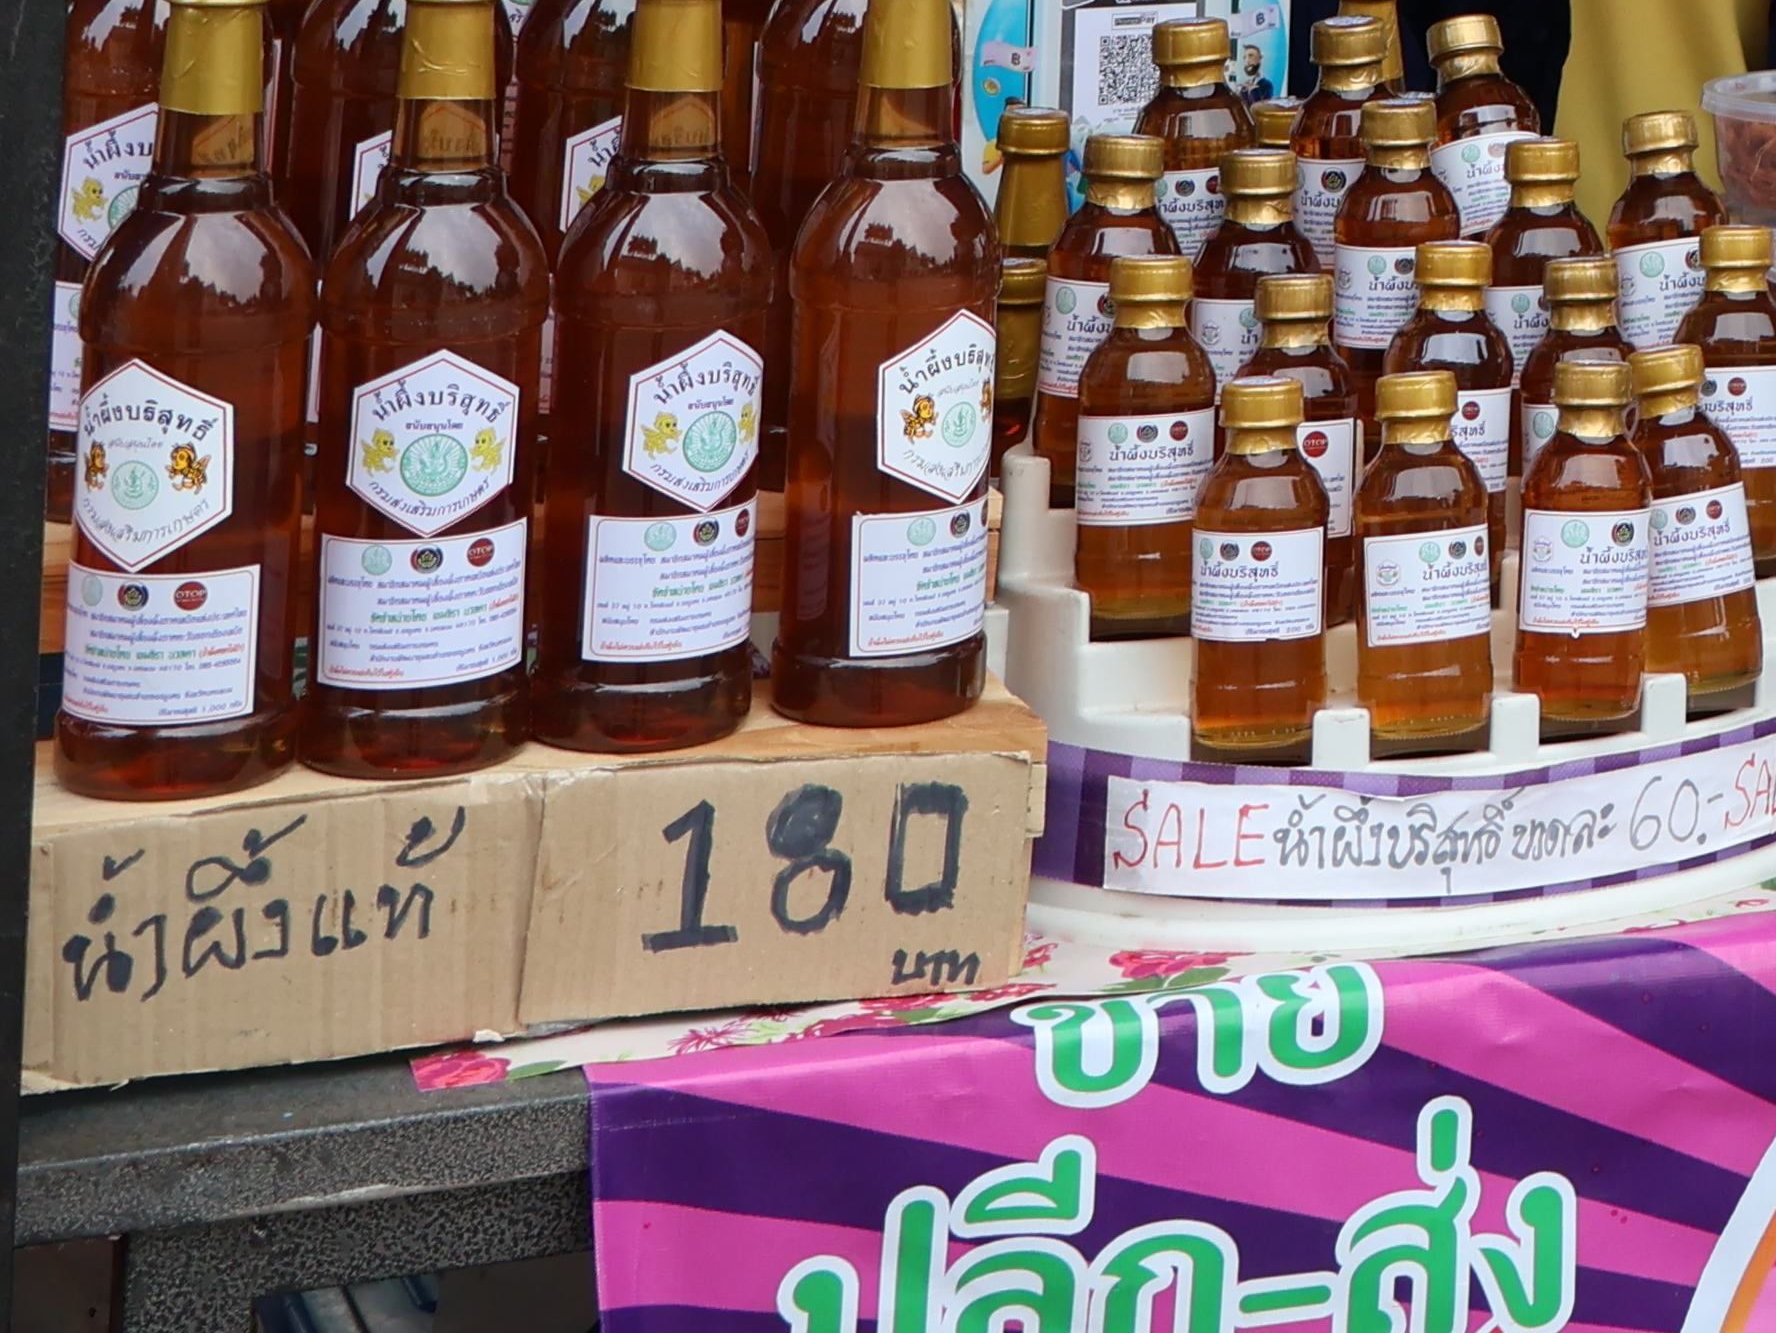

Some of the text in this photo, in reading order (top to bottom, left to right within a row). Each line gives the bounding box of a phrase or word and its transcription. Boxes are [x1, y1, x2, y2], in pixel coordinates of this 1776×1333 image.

[175, 589, 207, 600] OTOP
[641, 782, 970, 953] 180
[1113, 789, 1269, 870] SALE
[890, 948, 980, 985] บาท
[1011, 961, 1384, 1109] ขาย
[776, 1095, 1575, 1333] ปลีก-ส่ง
